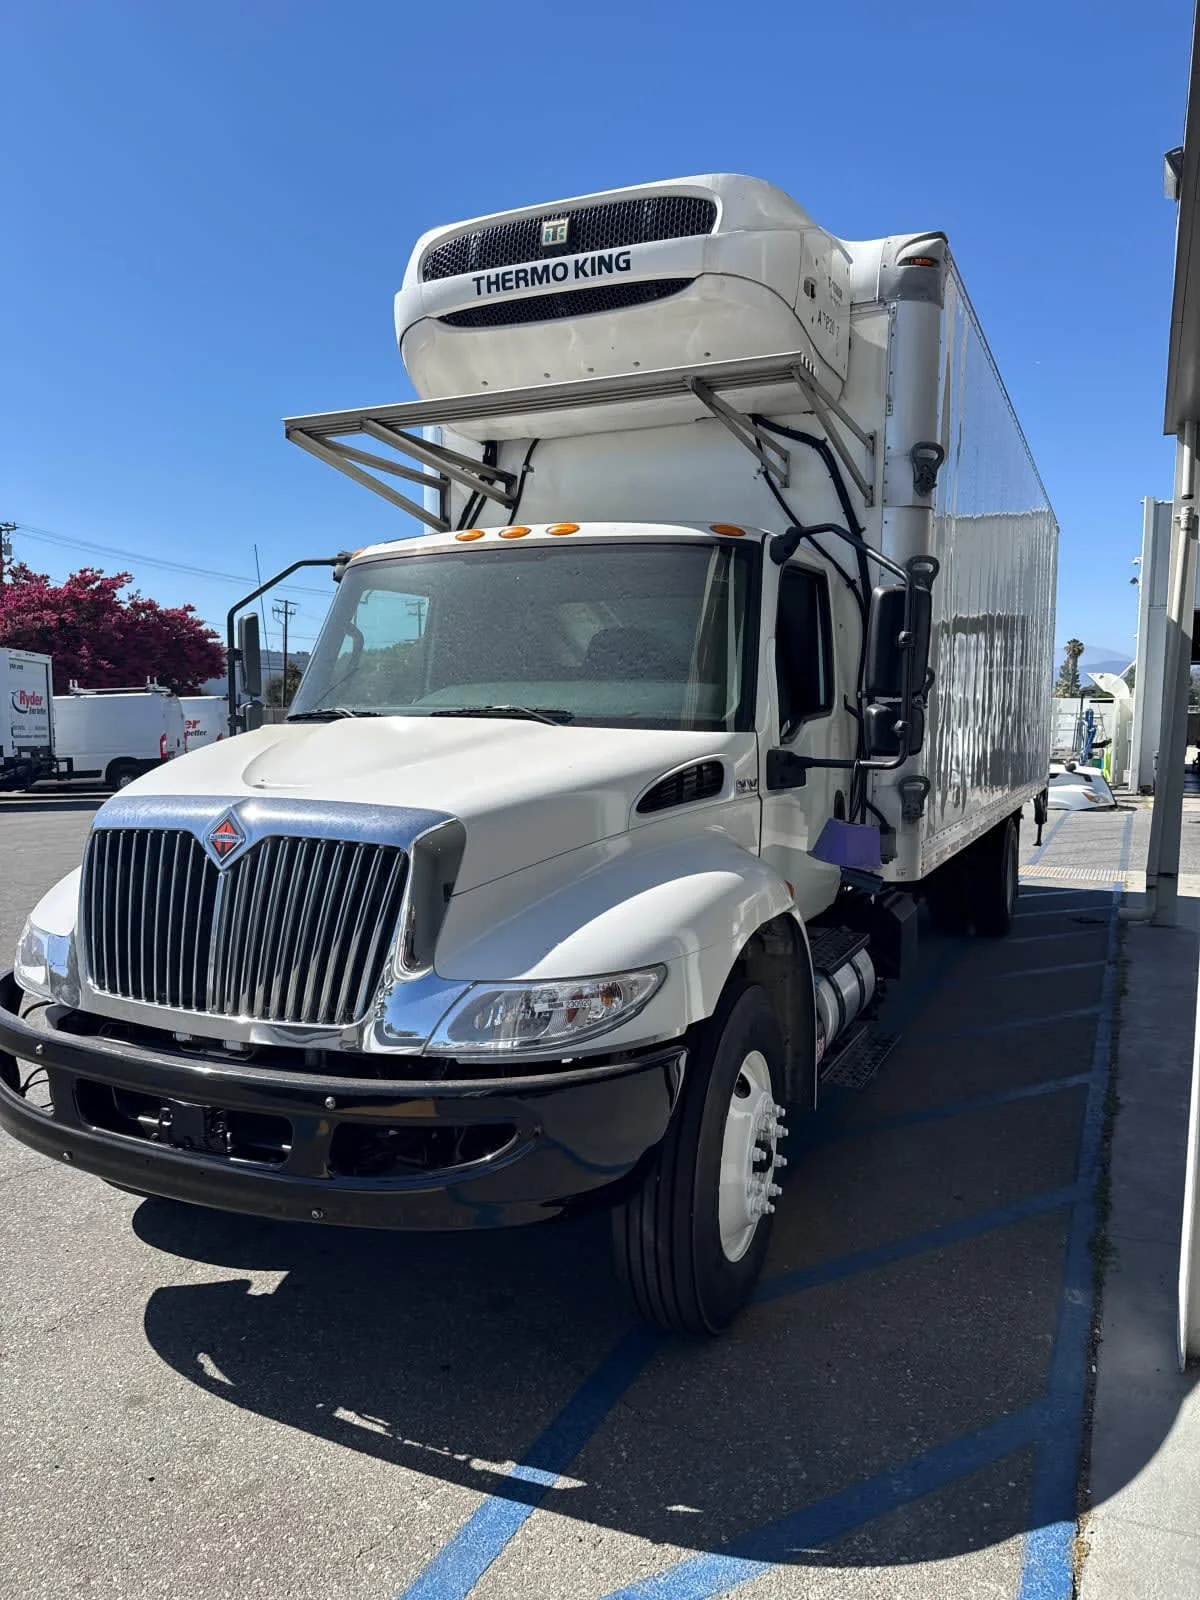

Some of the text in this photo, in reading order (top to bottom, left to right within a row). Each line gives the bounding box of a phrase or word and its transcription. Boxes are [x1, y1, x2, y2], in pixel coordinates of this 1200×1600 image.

[472, 251, 631, 296] THERMO KING
[20, 690, 43, 708] Ryder
